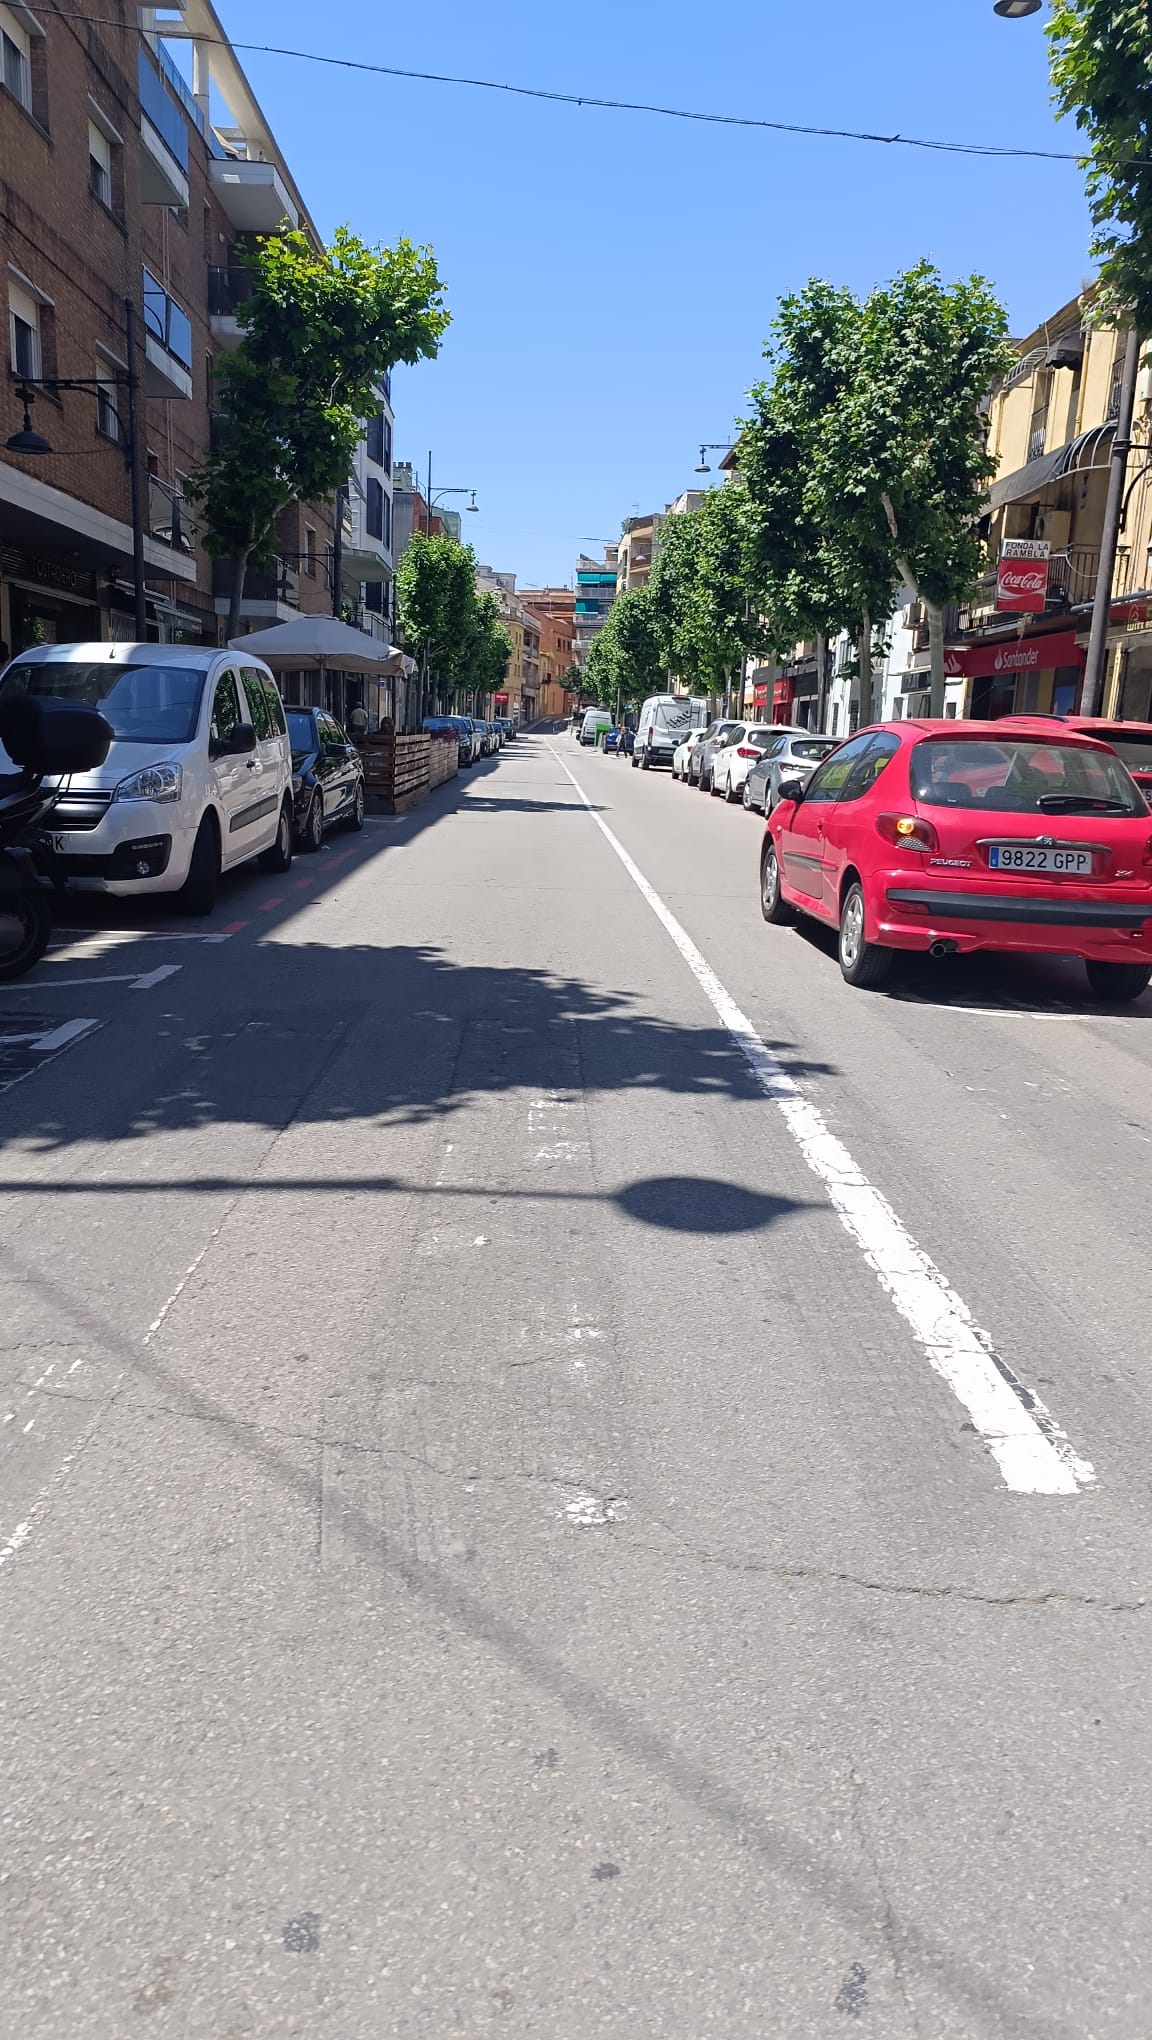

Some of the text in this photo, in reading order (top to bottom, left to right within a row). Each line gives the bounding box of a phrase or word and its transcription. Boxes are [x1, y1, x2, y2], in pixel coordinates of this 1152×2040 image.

[1006, 542, 1049, 551] FONDA LA
[1006, 549, 1045, 558] RAMBLA
[1002, 648, 1038, 668] Santander
[930, 858, 972, 867] PEUGEOT
[1001, 850, 1088, 871] 9822 GPP
